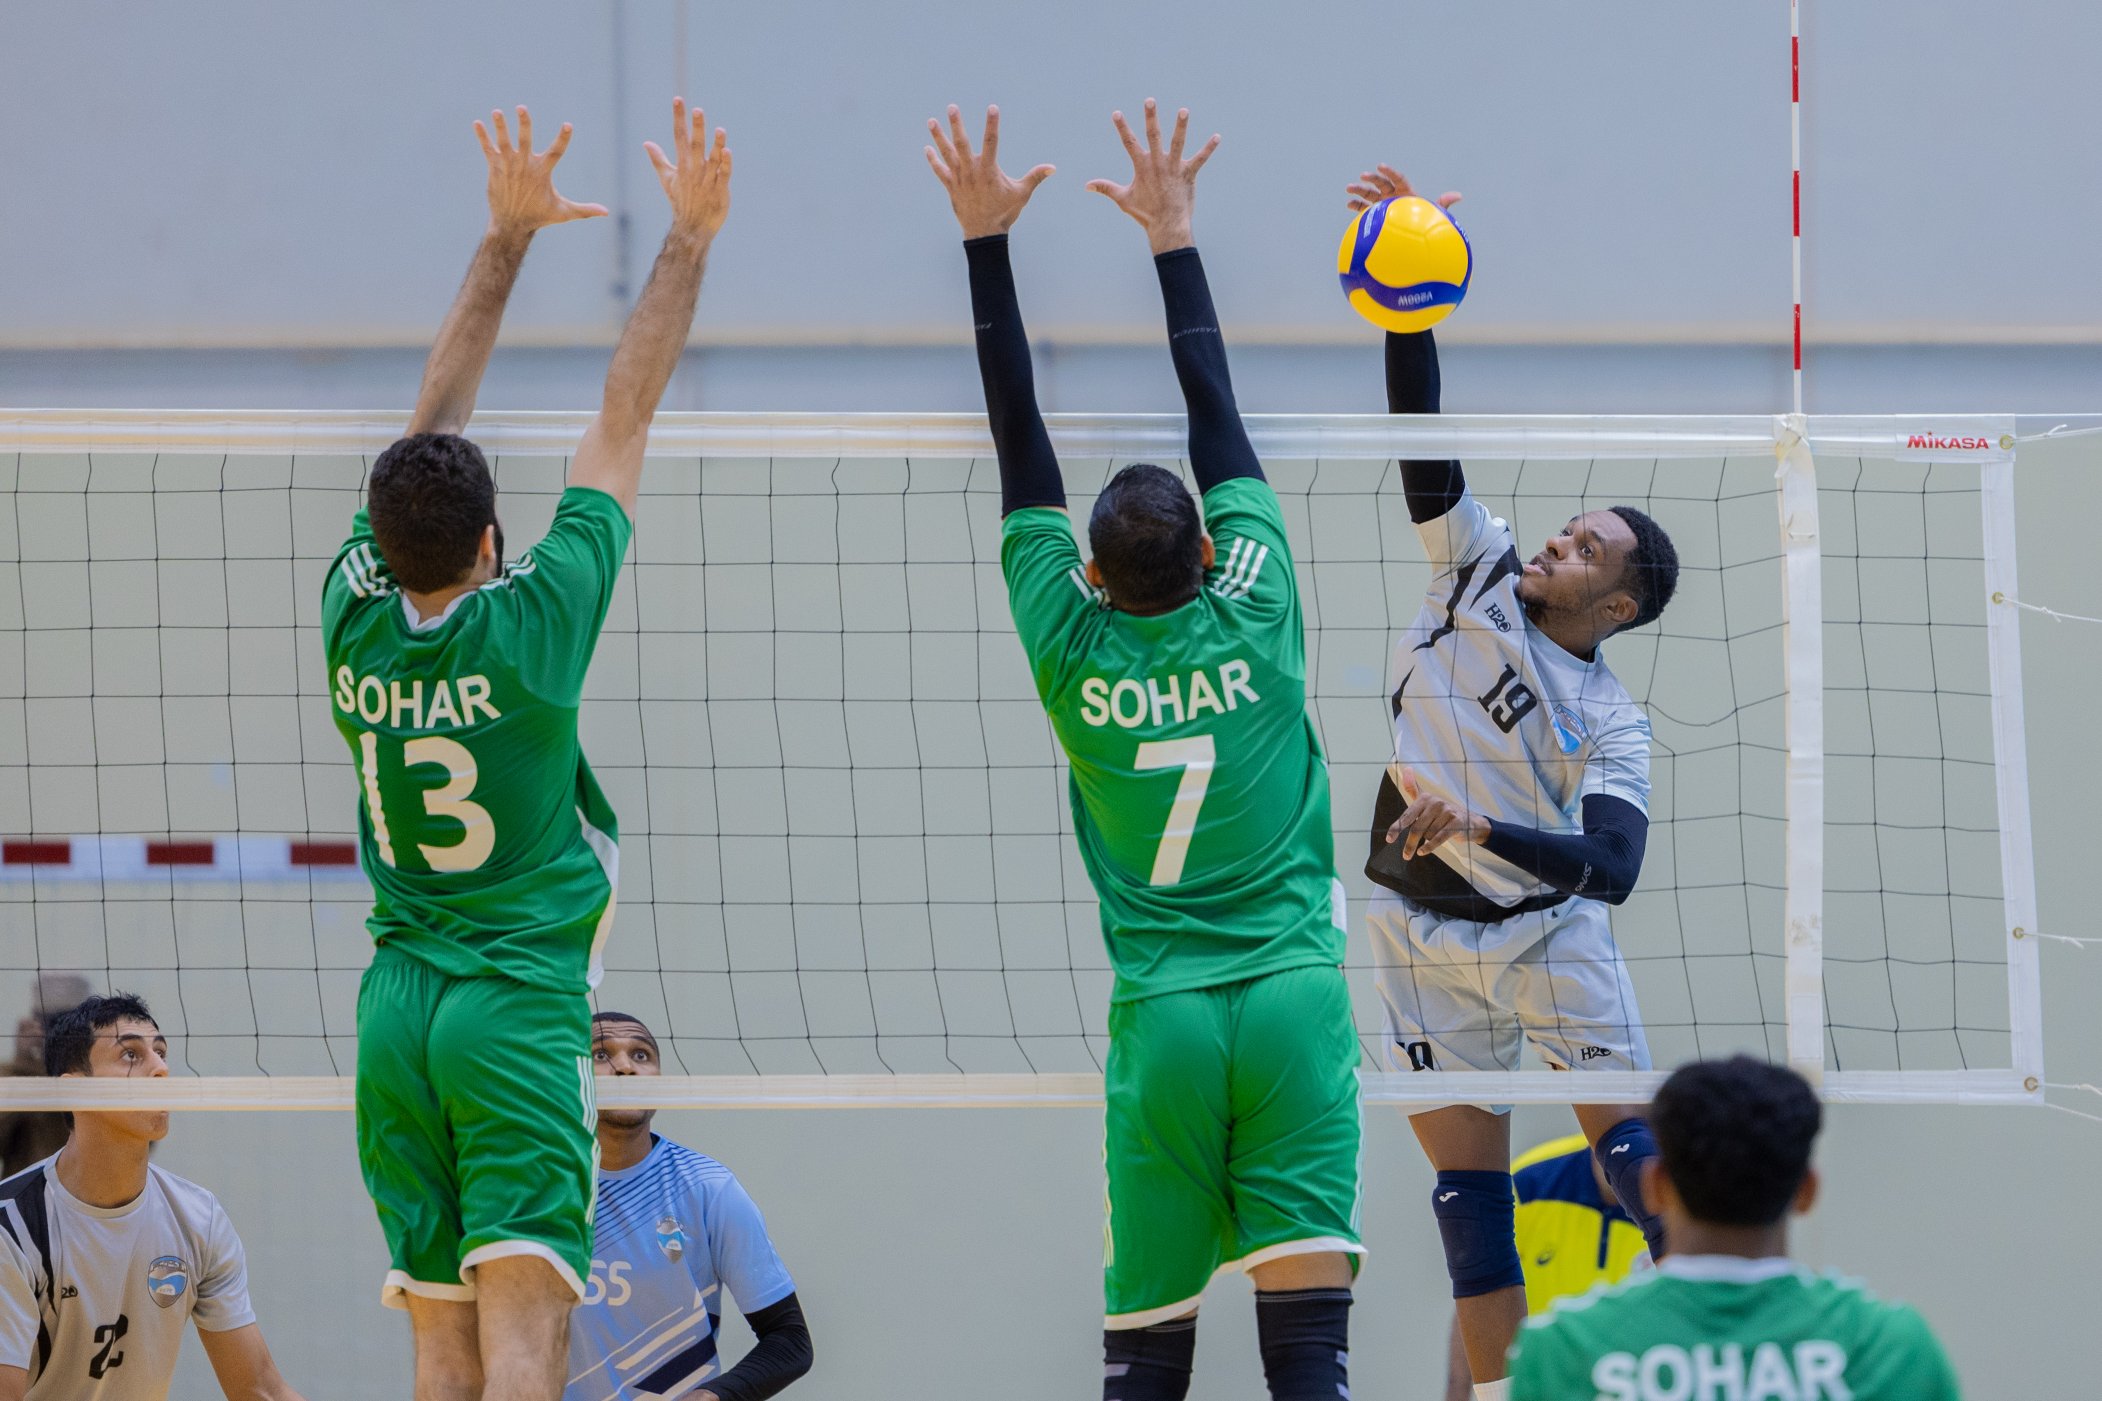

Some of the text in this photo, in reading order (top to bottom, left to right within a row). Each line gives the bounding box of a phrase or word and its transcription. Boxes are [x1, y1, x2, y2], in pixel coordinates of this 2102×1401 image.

[336, 664, 502, 729] SOHAR
[1080, 658, 1261, 729] SOHAR
[1477, 663, 1538, 734] 19
[358, 730, 496, 873] 13
[1133, 733, 1217, 887] 7
[88, 1314, 129, 1380] 2
[1592, 1339, 1856, 1401] SOHAR
